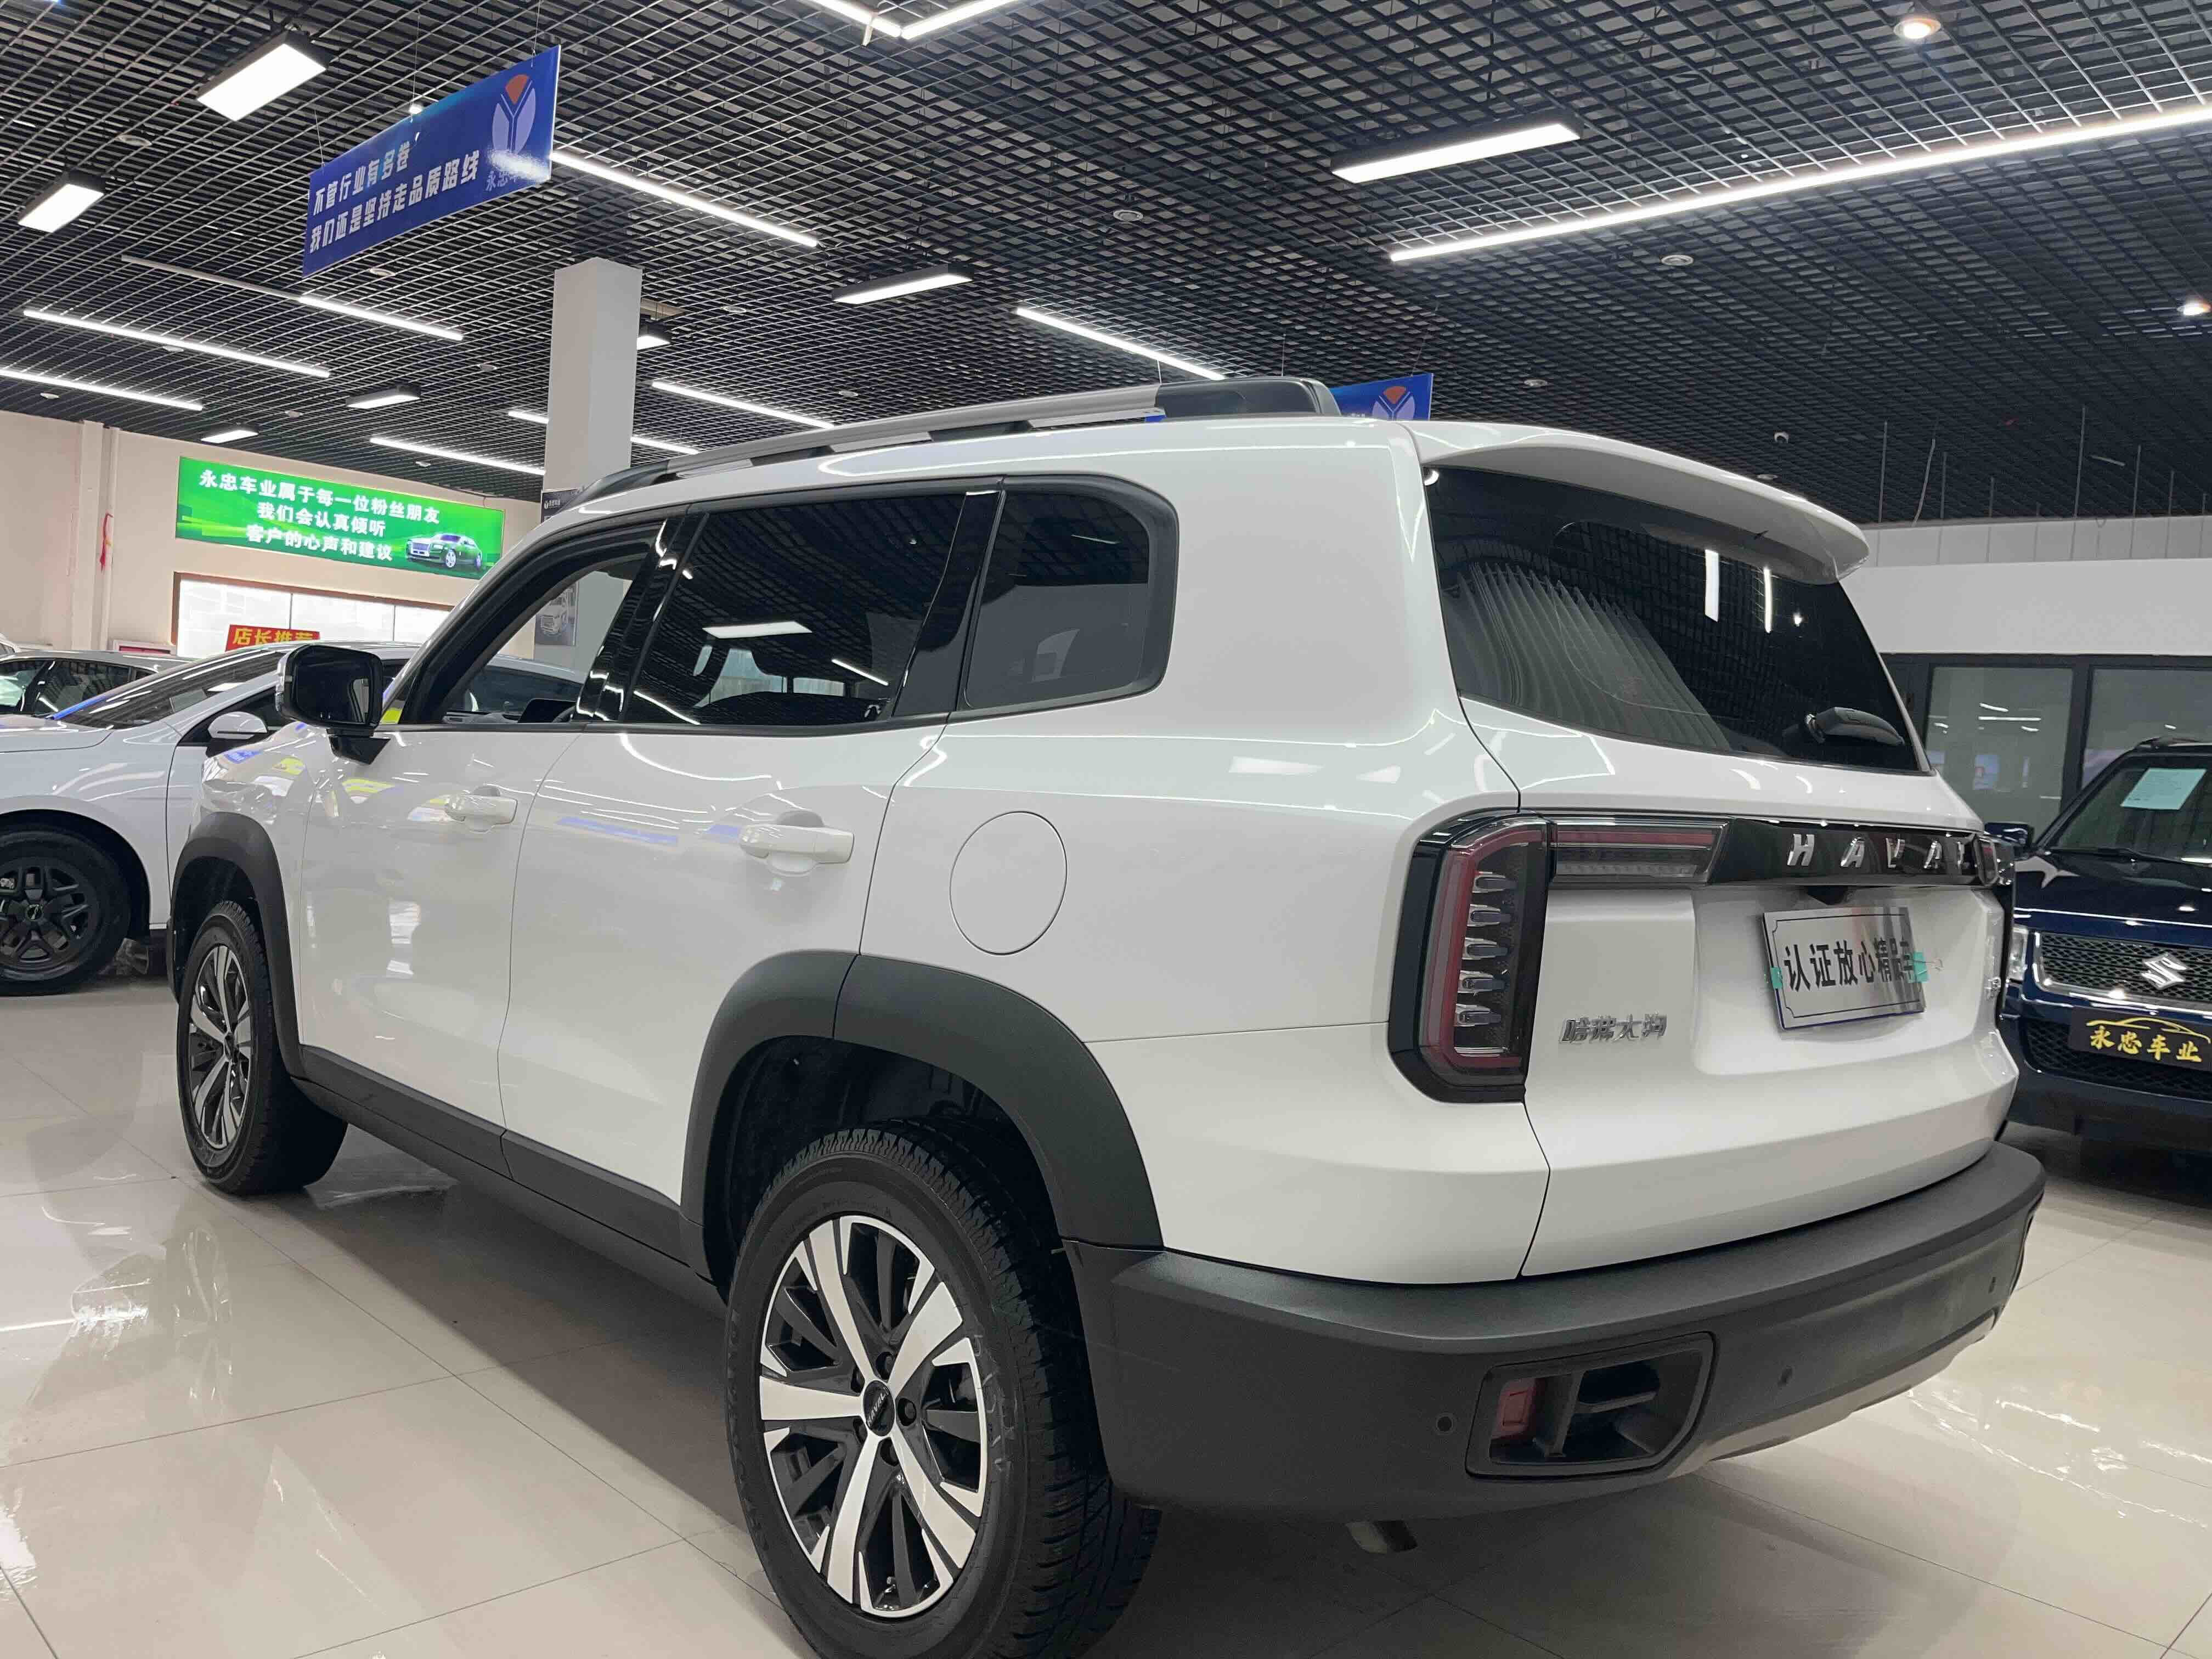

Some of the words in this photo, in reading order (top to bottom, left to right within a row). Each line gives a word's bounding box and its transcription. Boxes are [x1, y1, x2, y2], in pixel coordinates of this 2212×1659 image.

[313, 141, 410, 216] 不管行业有多卷
[309, 149, 480, 254] 我们还是坚持走品质路线
[199, 469, 440, 524] 永忠车业属于每一位粉丝朋友
[257, 501, 386, 537] 我们会认真倾听
[246, 524, 393, 562] 客户的心声和建议
[1787, 833, 1971, 870] HAVAL
[2090, 1025, 2202, 1063] 永忠车业
[867, 1386, 889, 1427] HAVAL
